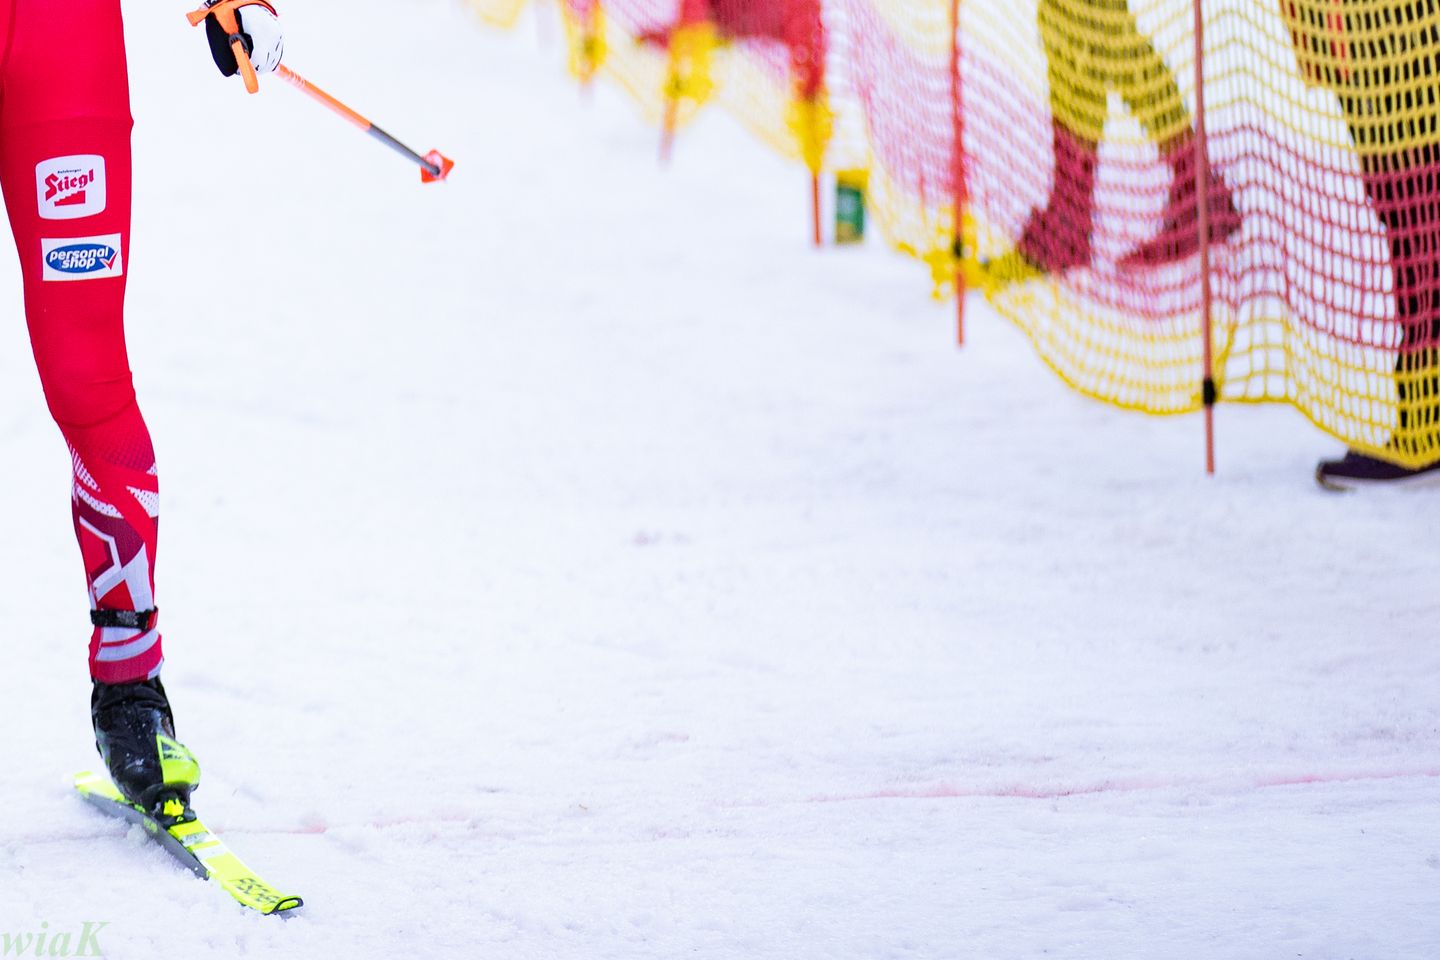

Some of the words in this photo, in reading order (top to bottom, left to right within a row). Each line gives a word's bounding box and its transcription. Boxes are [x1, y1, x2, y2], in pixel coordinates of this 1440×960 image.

[44, 168, 95, 202] Stiegl
[48, 246, 110, 263] personal
[61, 255, 97, 270] shop
